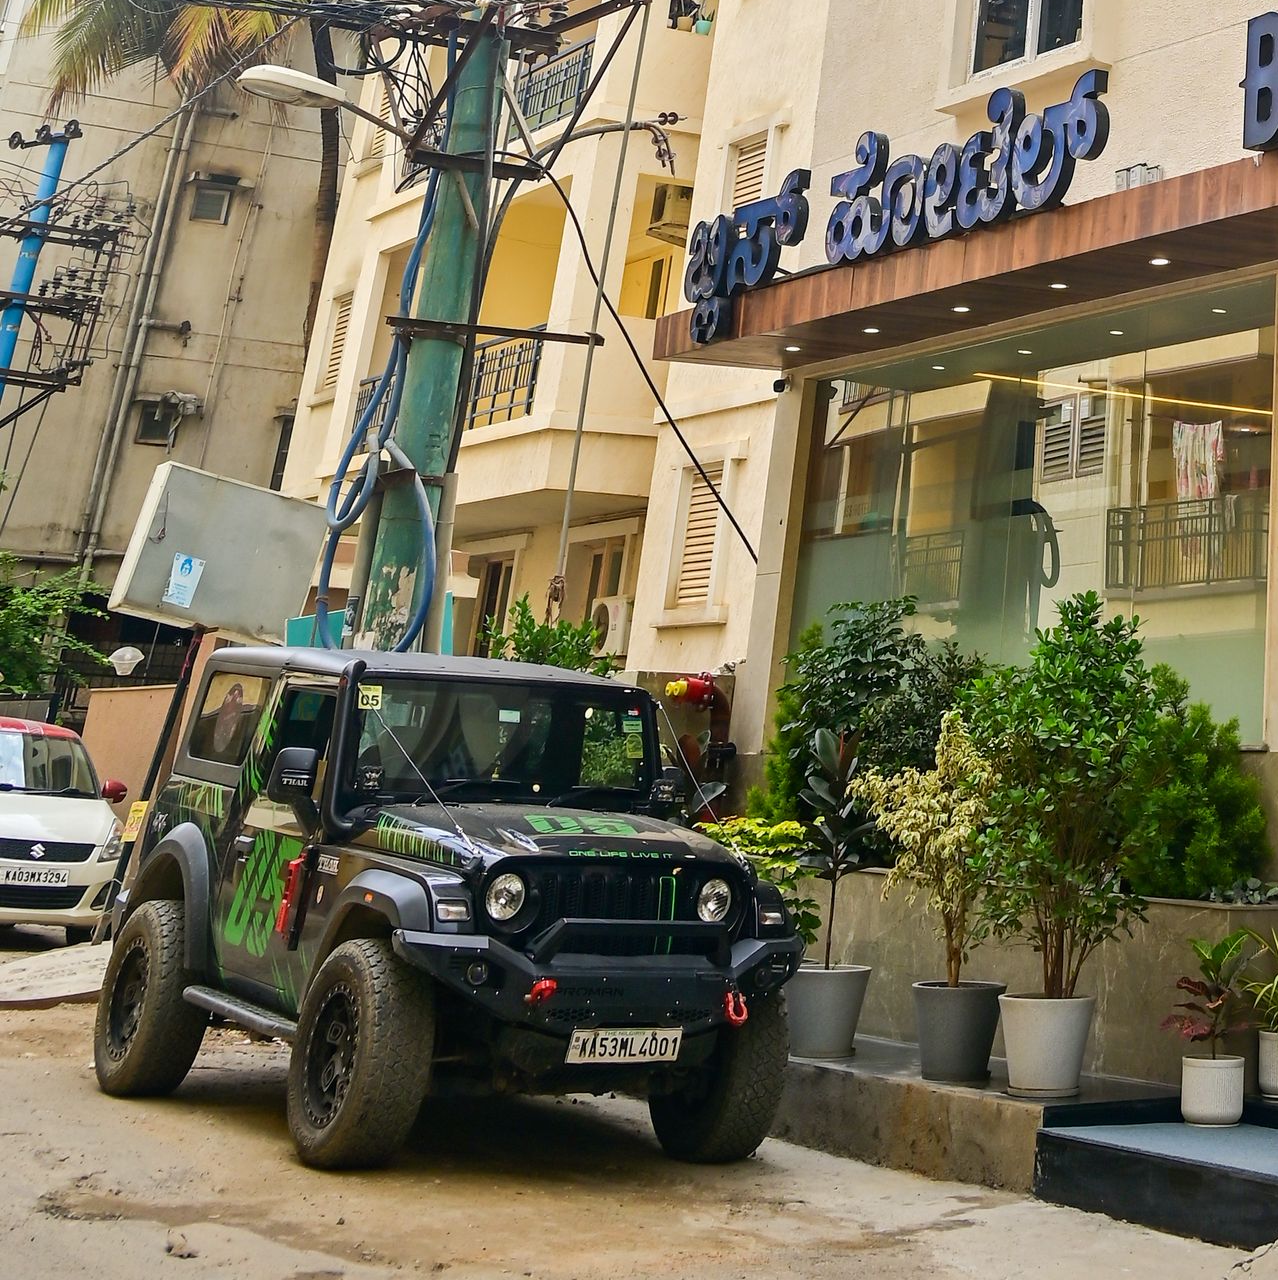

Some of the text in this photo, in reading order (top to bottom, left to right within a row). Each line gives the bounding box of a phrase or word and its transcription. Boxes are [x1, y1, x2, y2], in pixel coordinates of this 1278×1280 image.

[684, 69, 1110, 343] ಬ್ಲಿಸ್ ಹೋಟೆಲ್
[361, 694, 379, 707] 05
[282, 777, 309, 787] THAR
[524, 814, 638, 836] 05
[599, 850, 629, 858] LIFE
[631, 851, 660, 859] LIVE
[318, 856, 340, 872] THAR
[4, 869, 69, 884] KA03MX3294
[578, 1036, 679, 1058] KA53ML4001
